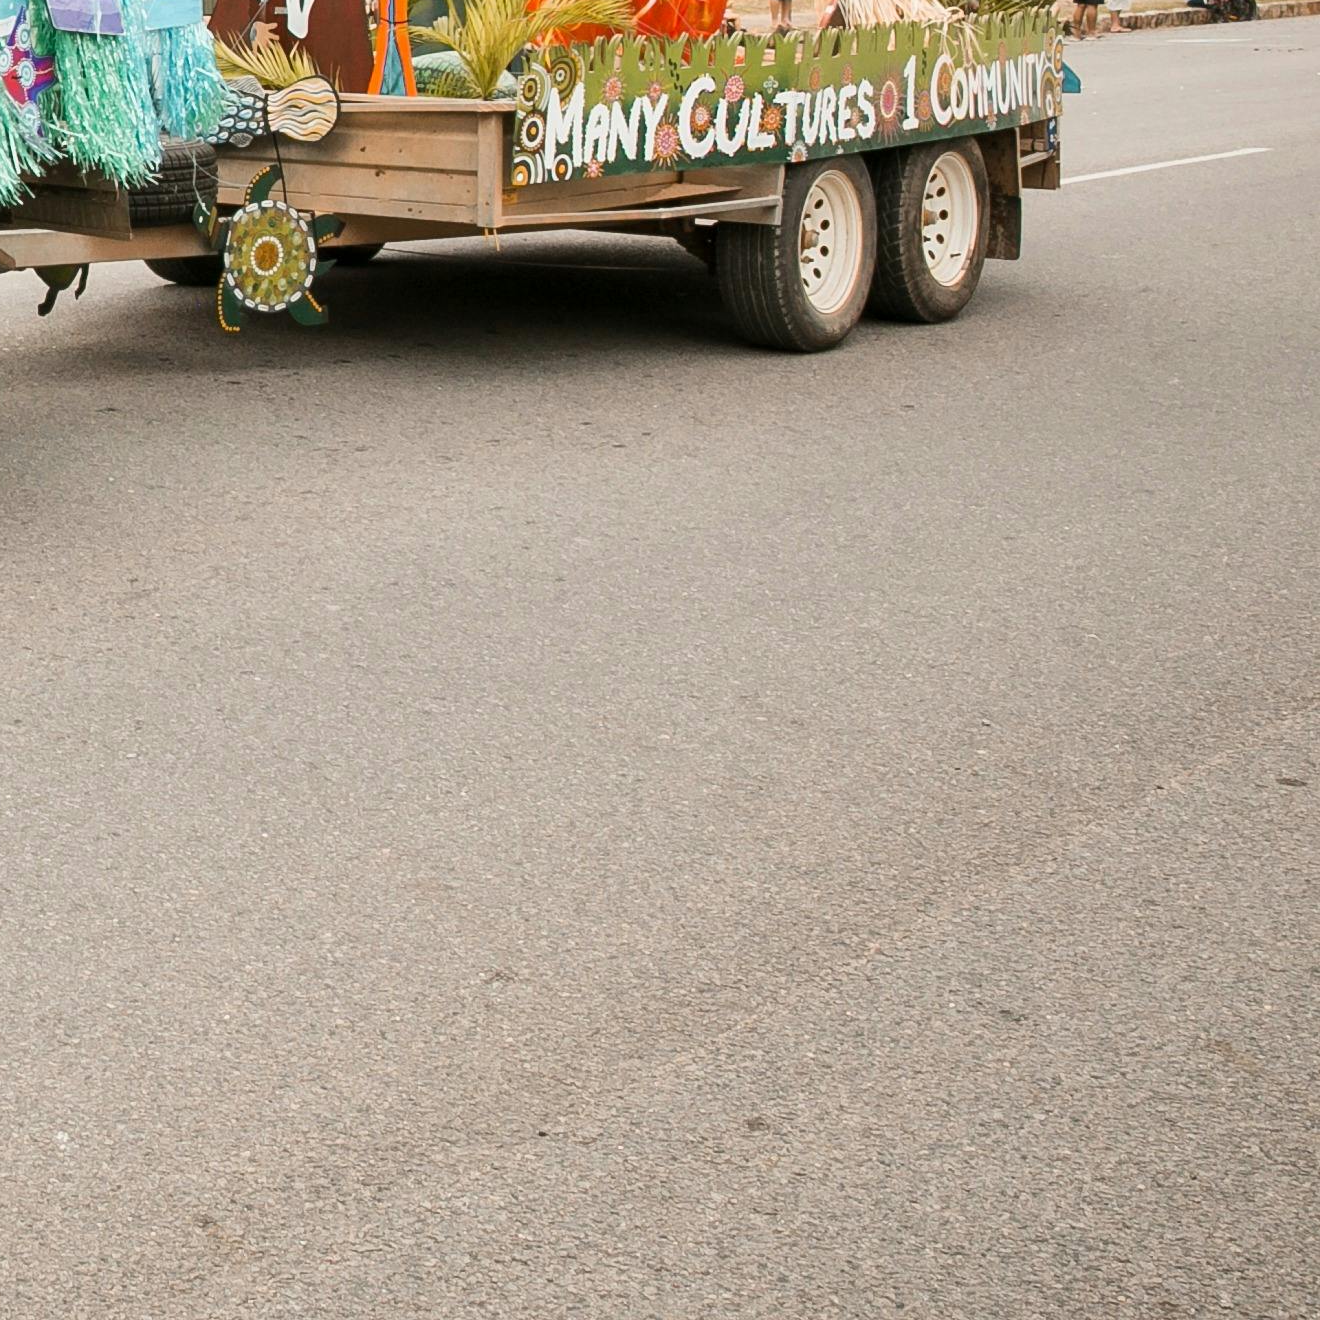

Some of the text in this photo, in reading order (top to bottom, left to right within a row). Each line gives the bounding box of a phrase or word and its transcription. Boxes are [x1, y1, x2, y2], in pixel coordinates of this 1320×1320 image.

[545, 51, 1046, 170] MANY CULTURES 1 COMMUNITY
